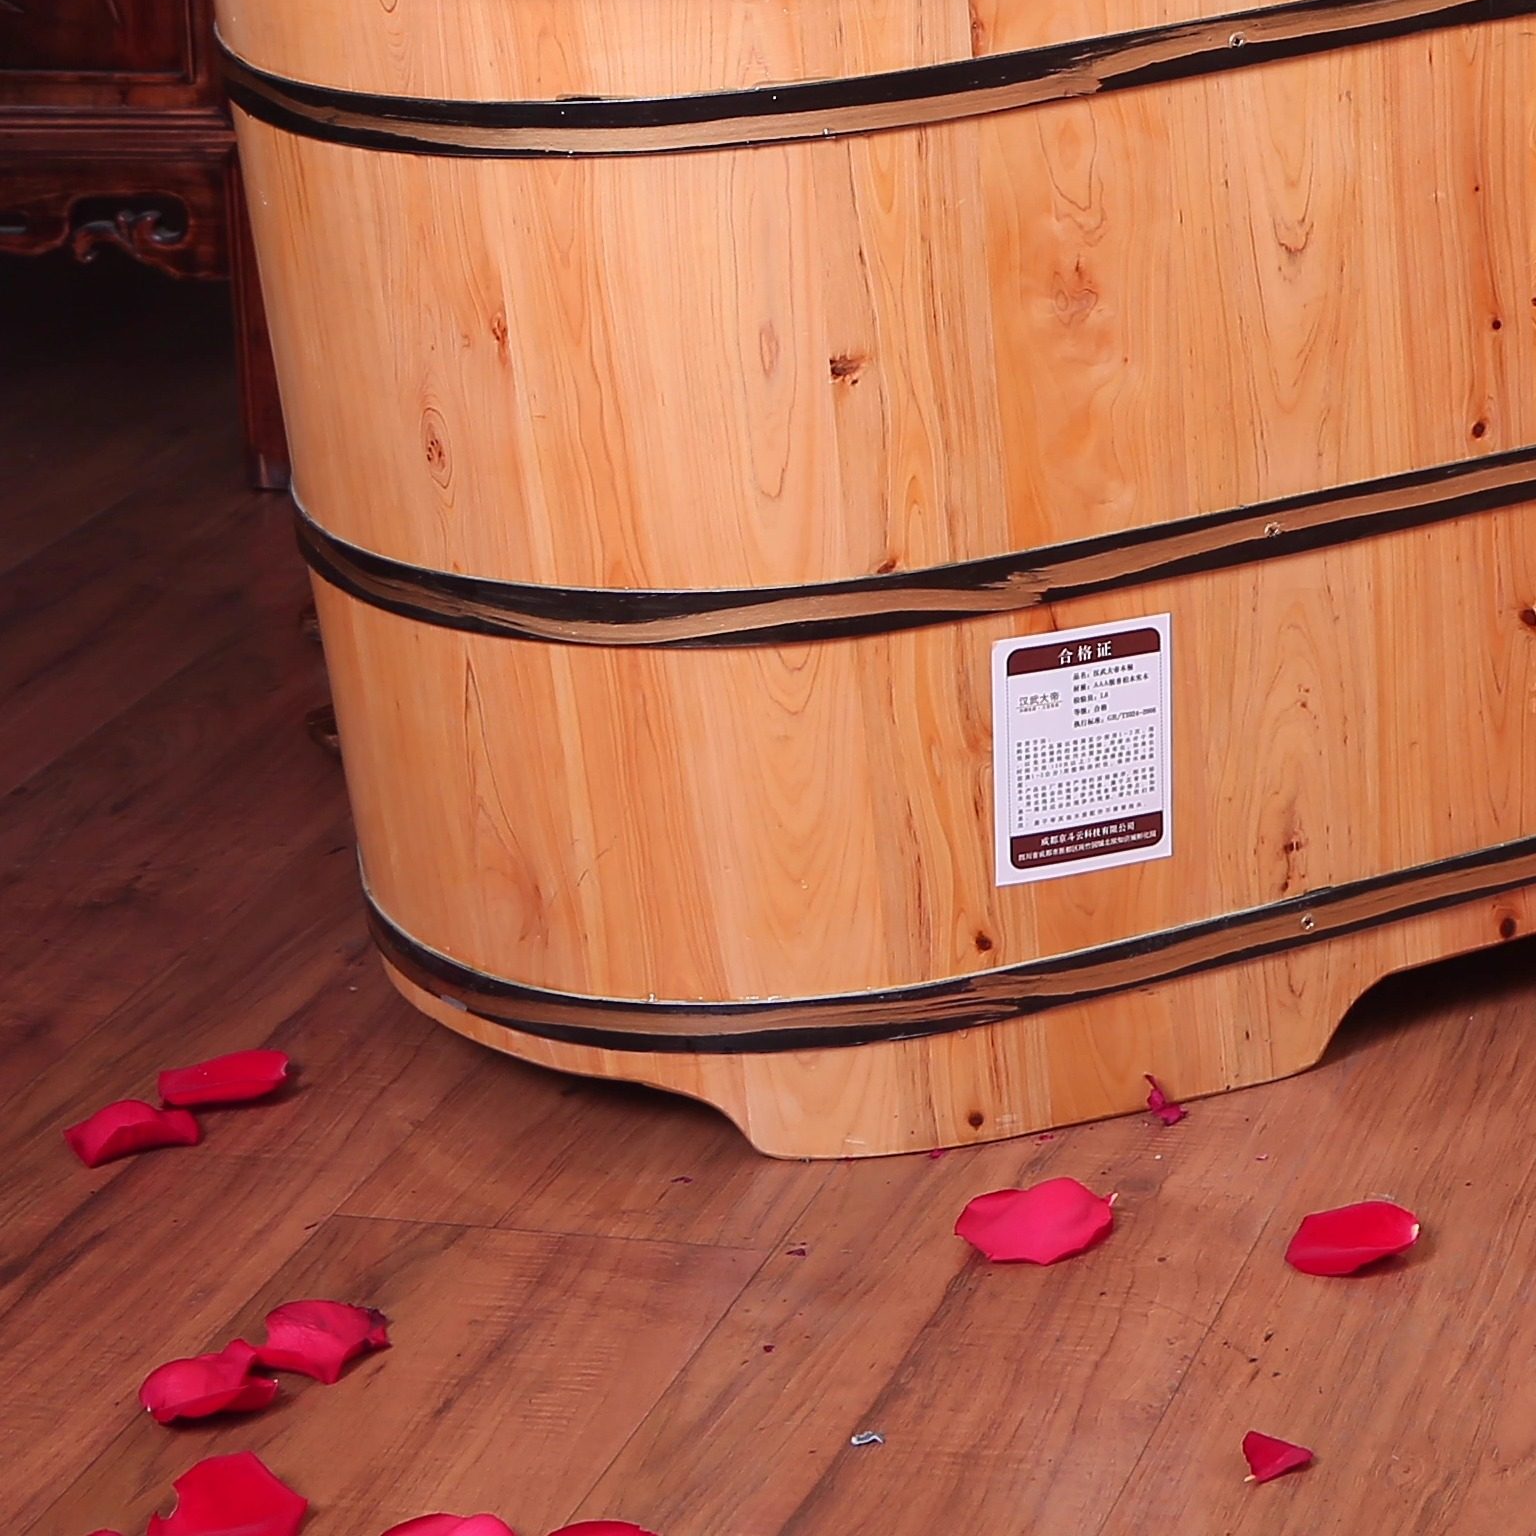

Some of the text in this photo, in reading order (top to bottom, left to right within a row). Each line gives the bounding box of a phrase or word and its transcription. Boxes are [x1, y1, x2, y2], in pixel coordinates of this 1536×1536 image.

[1057, 640, 1113, 665] 合格证
[1019, 691, 1060, 706] 汉武大帝
